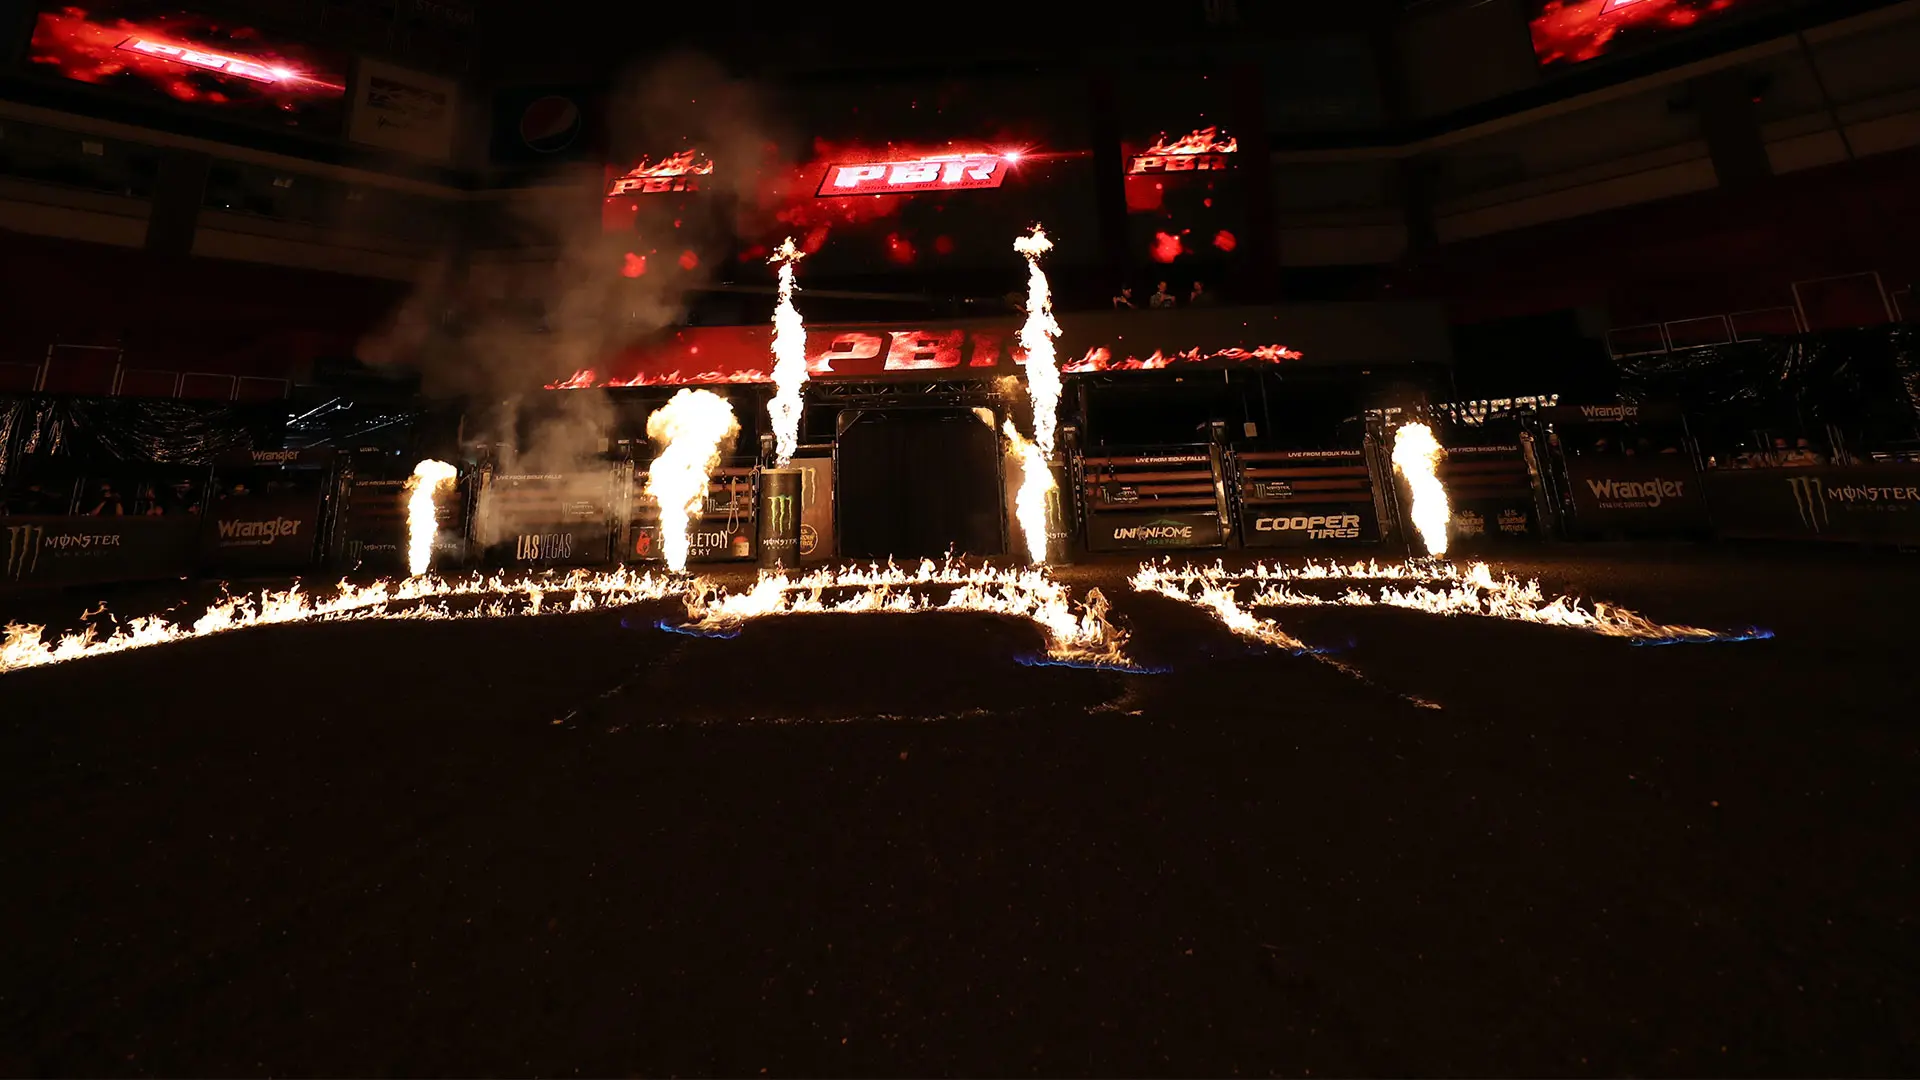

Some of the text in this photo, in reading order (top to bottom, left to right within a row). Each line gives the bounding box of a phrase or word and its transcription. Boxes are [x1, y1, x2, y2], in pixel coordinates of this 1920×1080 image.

[833, 157, 999, 188] PBR
[1129, 155, 1227, 175] PBR
[1580, 405, 1638, 421] Wrangler
[251, 450, 300, 465] Wrangler
[1586, 477, 1684, 508] Wrangler
[1827, 484, 1920, 502] MONSTER
[218, 516, 301, 545] Wrangler
[1255, 515, 1360, 531] COOPER
[45, 533, 120, 550] MONSTER
[1307, 528, 1361, 540] TIRES
